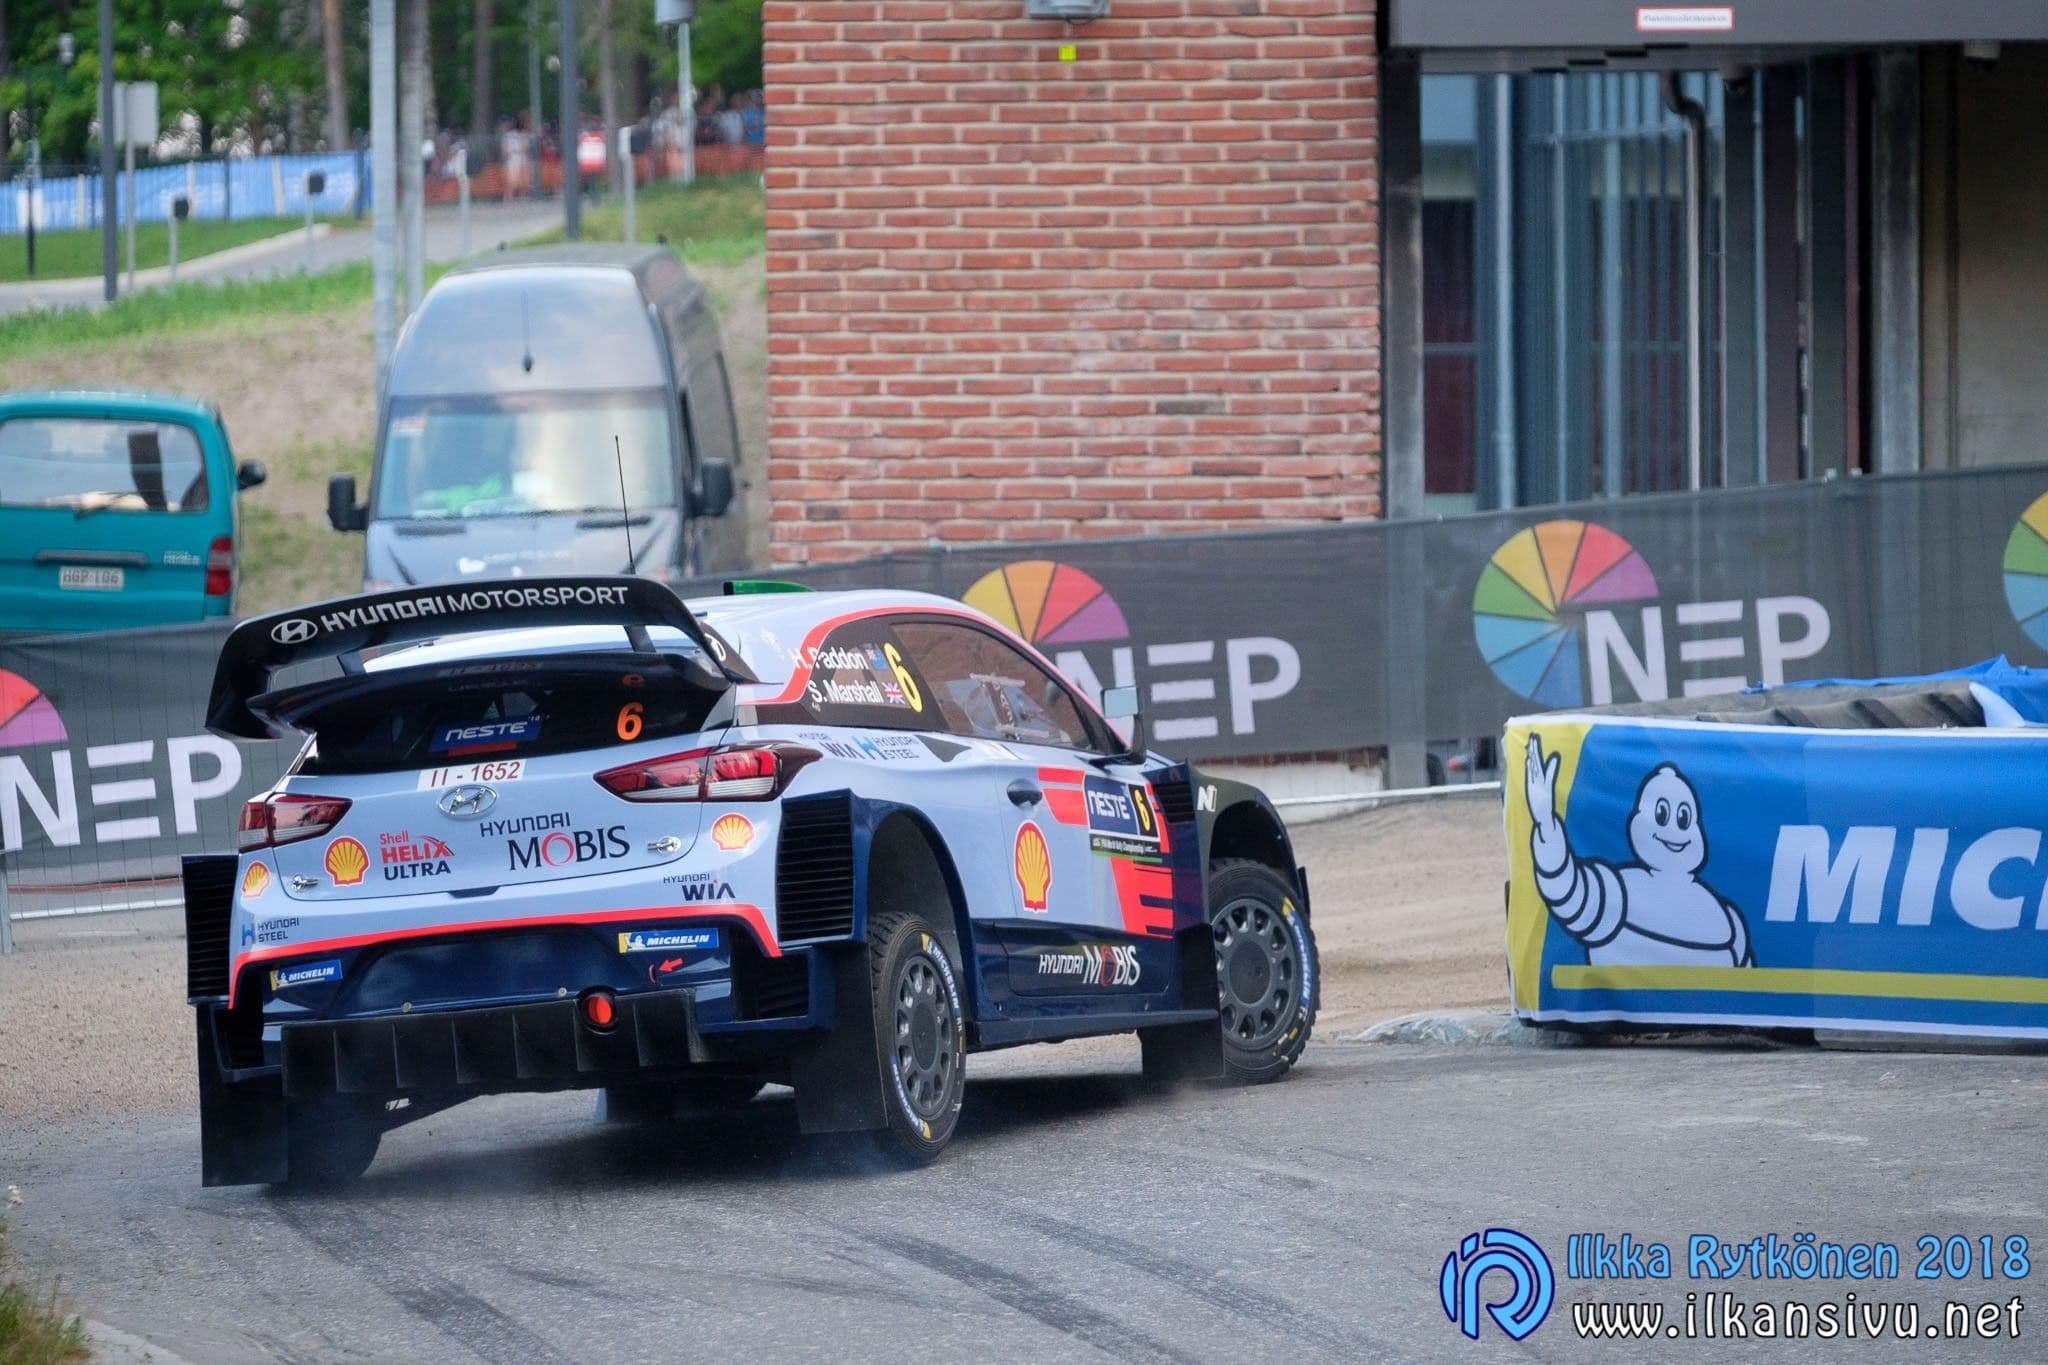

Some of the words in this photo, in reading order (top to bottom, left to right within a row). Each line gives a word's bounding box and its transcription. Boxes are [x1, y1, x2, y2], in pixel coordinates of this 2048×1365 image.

[321, 596, 447, 632] HYUNDAI
[449, 586, 629, 613] MOTORSPORT
[809, 646, 869, 670] Paddon
[1586, 596, 1831, 706] NEP
[883, 642, 923, 713] 6
[807, 681, 827, 703] S.
[823, 679, 885, 703] Marshall
[444, 721, 529, 742] NESTE
[616, 701, 645, 741] 6
[884, 748, 920, 759] STEEL
[470, 761, 521, 782] 1652
[0, 734, 242, 853] NEP
[1087, 789, 1131, 820] NESTE
[1134, 788, 1151, 832] 6
[480, 812, 570, 837] HYUNDAI
[379, 831, 409, 844] Shell
[508, 825, 631, 871] MOBIS
[381, 840, 453, 865] HELIX
[383, 860, 451, 881] ULTRA
[663, 872, 710, 884] HYUNDAI
[1765, 823, 2048, 931] MIC
[682, 880, 736, 901] WIA
[257, 917, 300, 929] HYUNDAI
[258, 930, 289, 943] STEEL
[647, 933, 710, 946] MICHELIN
[288, 966, 335, 983] MICHELIN
[1038, 953, 1085, 974] HYUNDAI
[1082, 944, 1141, 987] MOBIS
